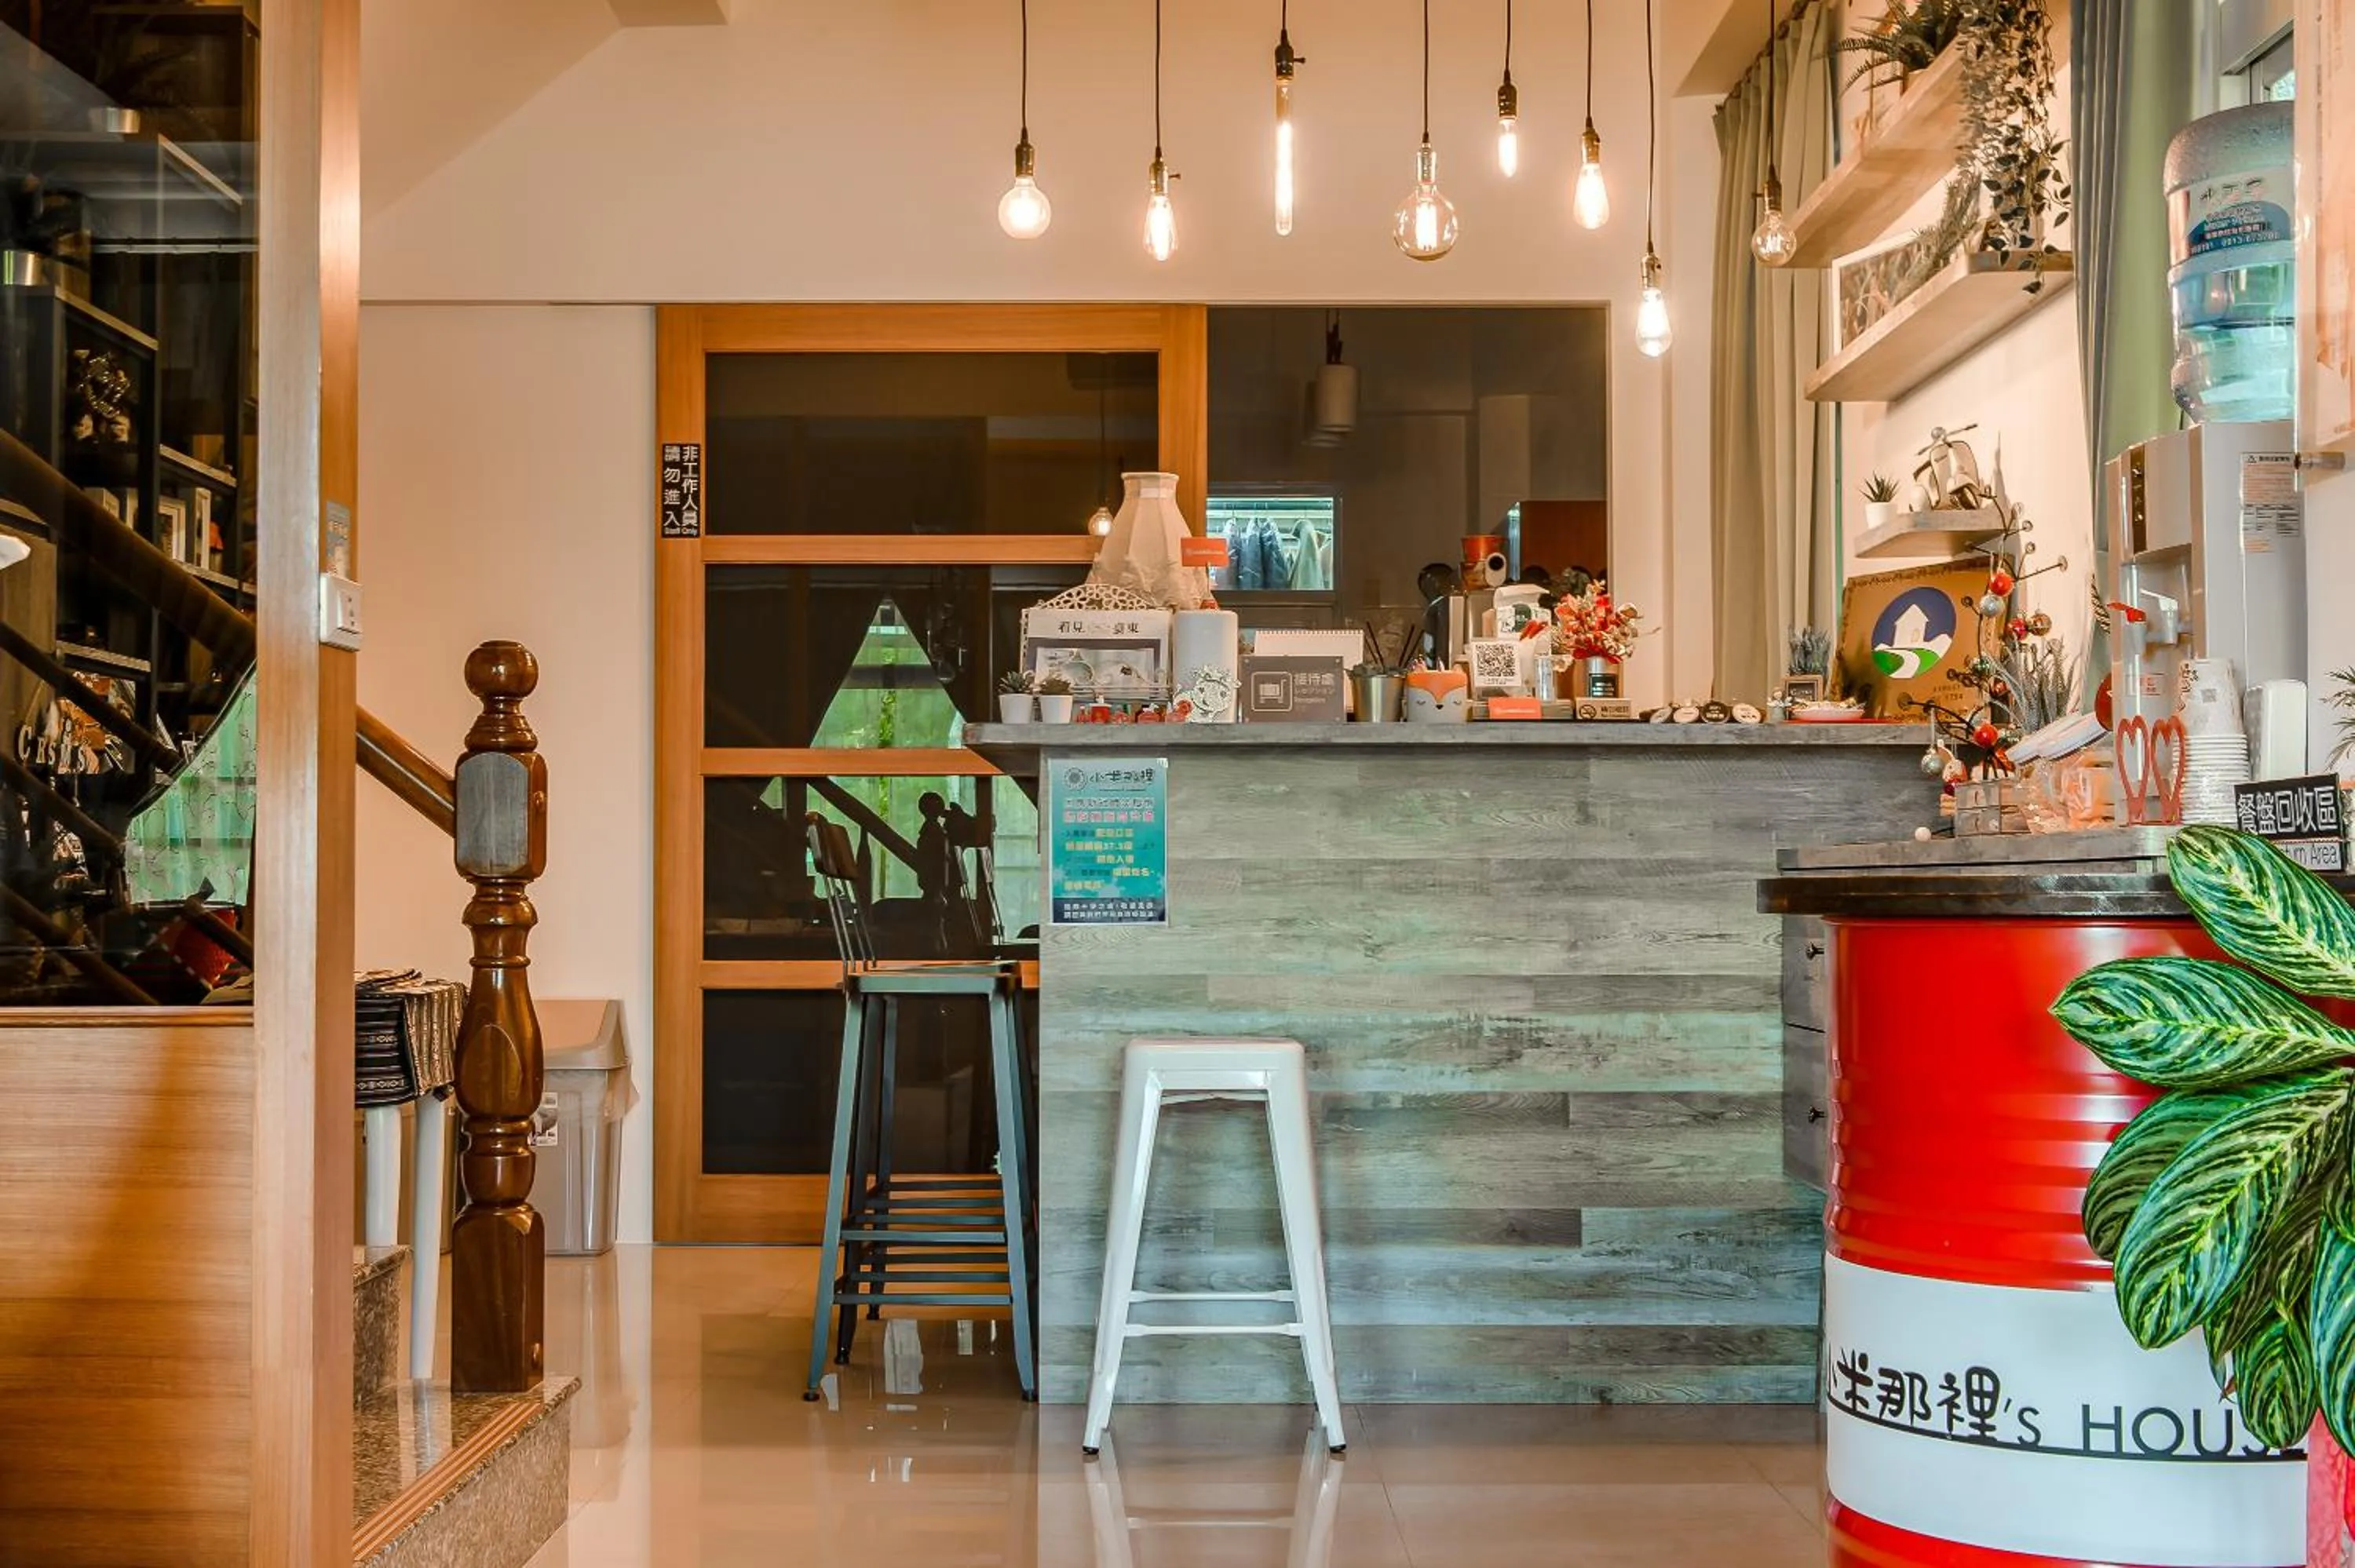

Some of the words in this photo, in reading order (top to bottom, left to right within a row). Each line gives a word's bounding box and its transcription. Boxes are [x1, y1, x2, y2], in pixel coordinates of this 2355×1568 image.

[664, 446, 681, 527] 請勿進入
[682, 446, 698, 527] 非工作人員
[2237, 786, 2338, 834] 餐盤回收區
[2311, 842, 2337, 864] Area
[2082, 1403, 2305, 1457] HOU
